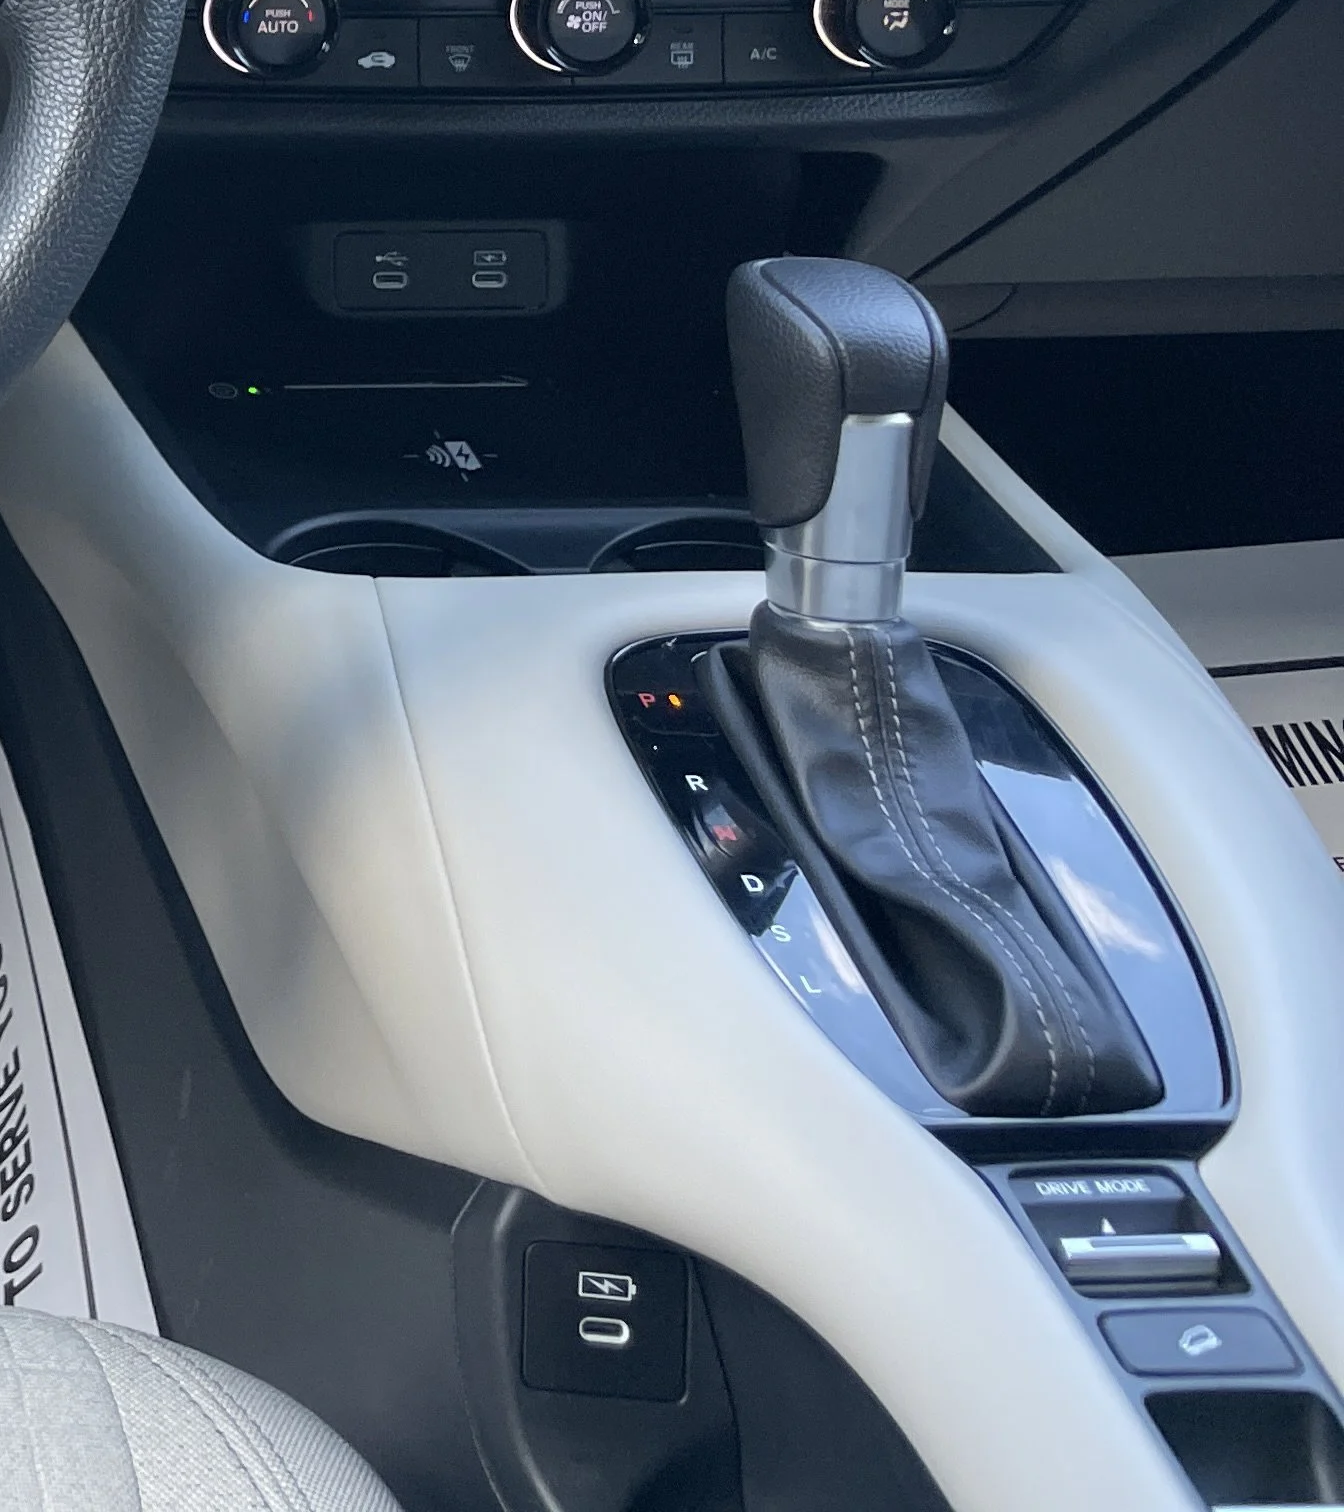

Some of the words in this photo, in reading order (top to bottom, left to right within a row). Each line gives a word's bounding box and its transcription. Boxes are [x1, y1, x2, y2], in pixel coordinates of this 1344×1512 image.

[575, 1, 601, 10] PUSH
[883, 0, 910, 9] MODE
[265, 9, 291, 18] PUSH
[582, 11, 607, 23] ON/
[257, 20, 299, 34] AUTO
[581, 22, 608, 33] OFF
[750, 47, 777, 60] A/C
[637, 692, 657, 708] P
[685, 774, 709, 791] R
[740, 873, 764, 893] D
[769, 924, 792, 943] S
[799, 975, 822, 994] L
[1034, 1180, 1093, 1197] DRIVE
[1095, 1179, 1151, 1194] MODE
[3, 1223, 43, 1307] TO
